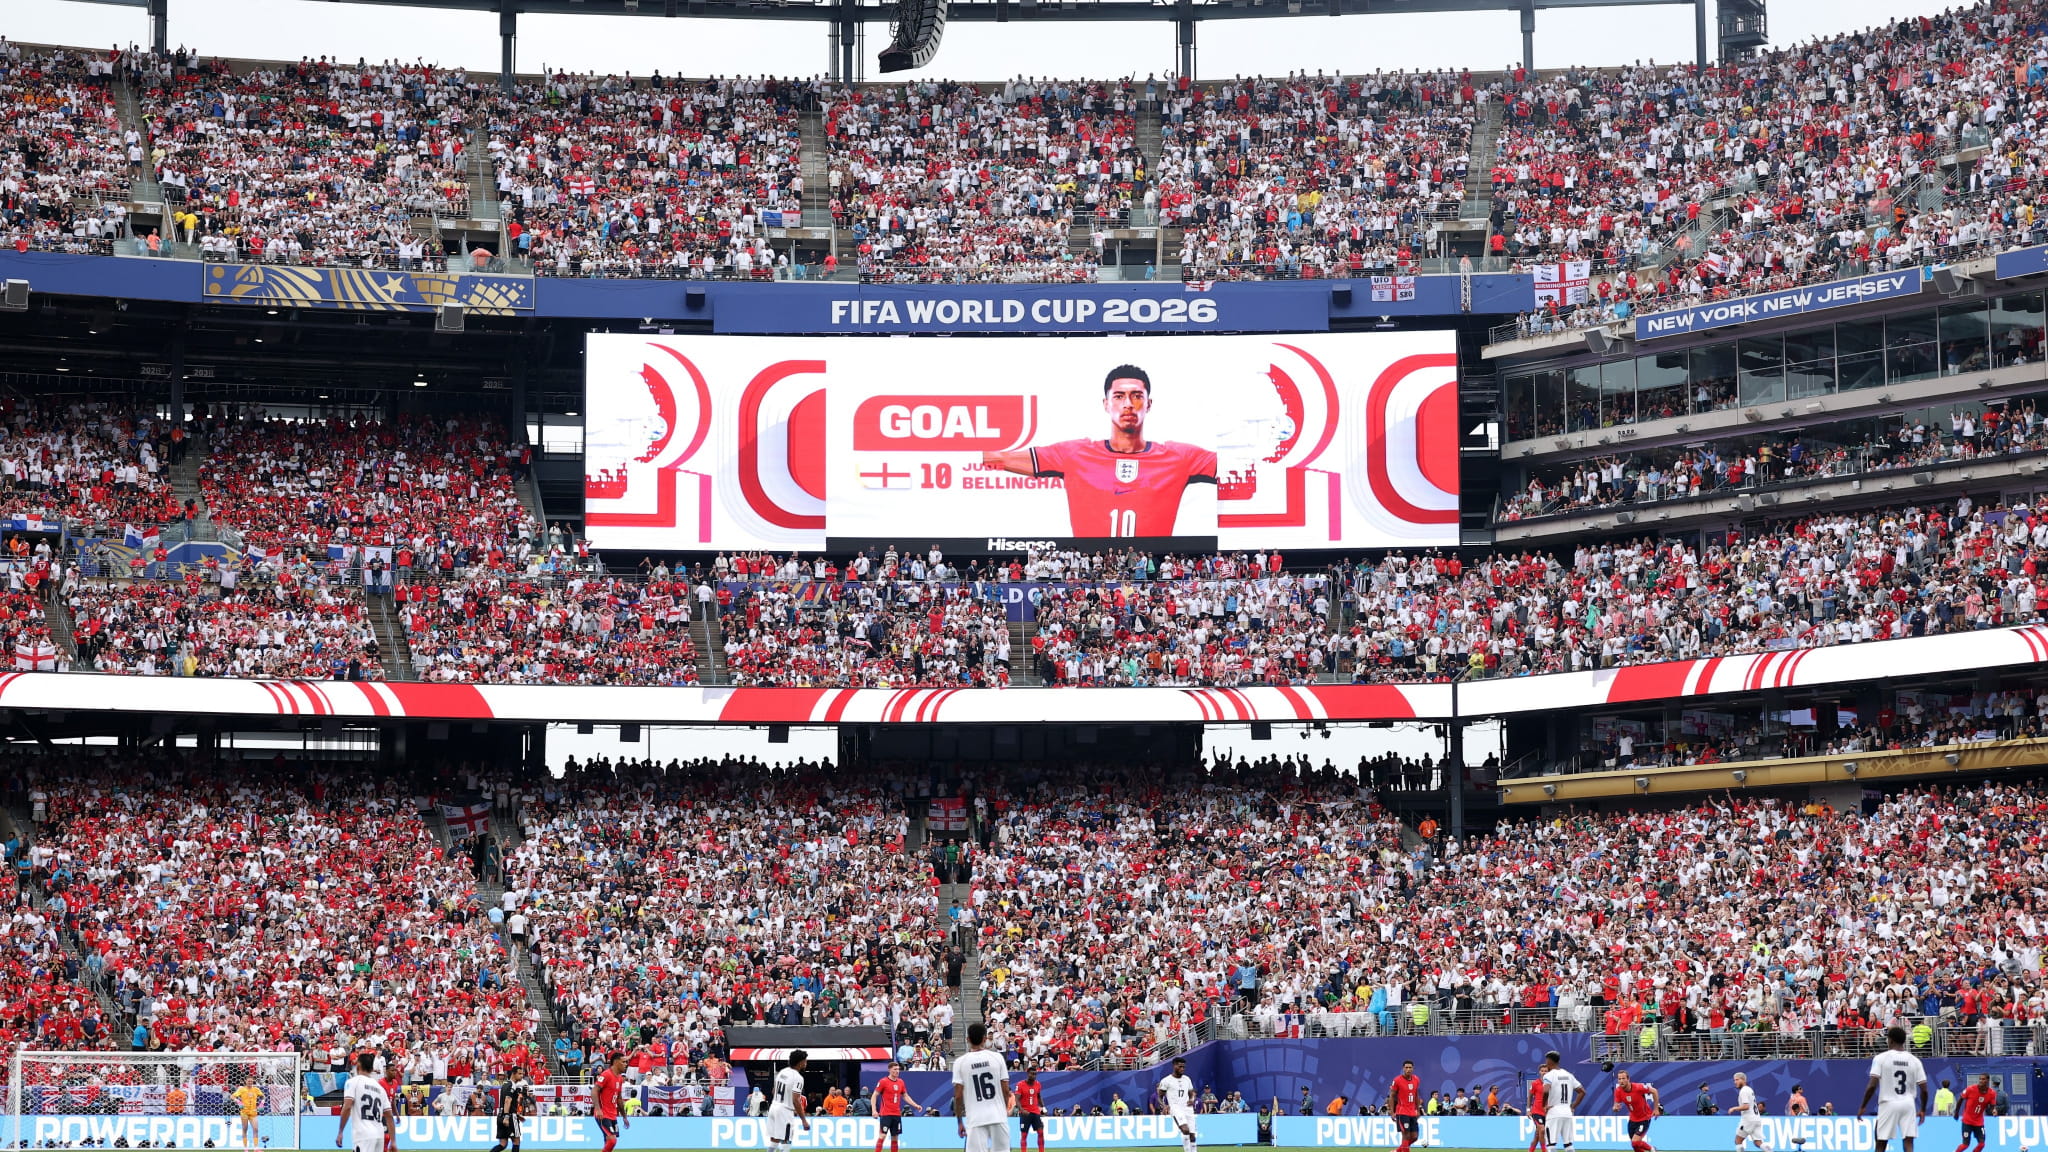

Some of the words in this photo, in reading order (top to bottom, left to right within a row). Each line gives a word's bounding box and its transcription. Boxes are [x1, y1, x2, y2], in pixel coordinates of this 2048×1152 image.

[1535, 281, 1575, 289] BIRMINGHAM
[831, 300, 901, 324] FIFA
[906, 299, 1025, 324] WORLD
[1031, 299, 1097, 323] CUP
[1103, 298, 1218, 323] 2026
[1647, 311, 1695, 333] NEW
[1700, 301, 1759, 324] YORK
[1763, 292, 1812, 312] NEW
[1817, 275, 1907, 303] JERSEY
[879, 404, 1000, 439] GOAL
[920, 463, 952, 489] 10
[962, 477, 1065, 490] BELLINGHA
[987, 538, 1057, 551] Hisense
[972, 1071, 996, 1102] 16
[1560, 1083, 1569, 1104] 11
[1894, 1070, 1907, 1095] 3
[361, 1093, 382, 1123] 26
[1316, 1116, 1441, 1146] POWERDE
